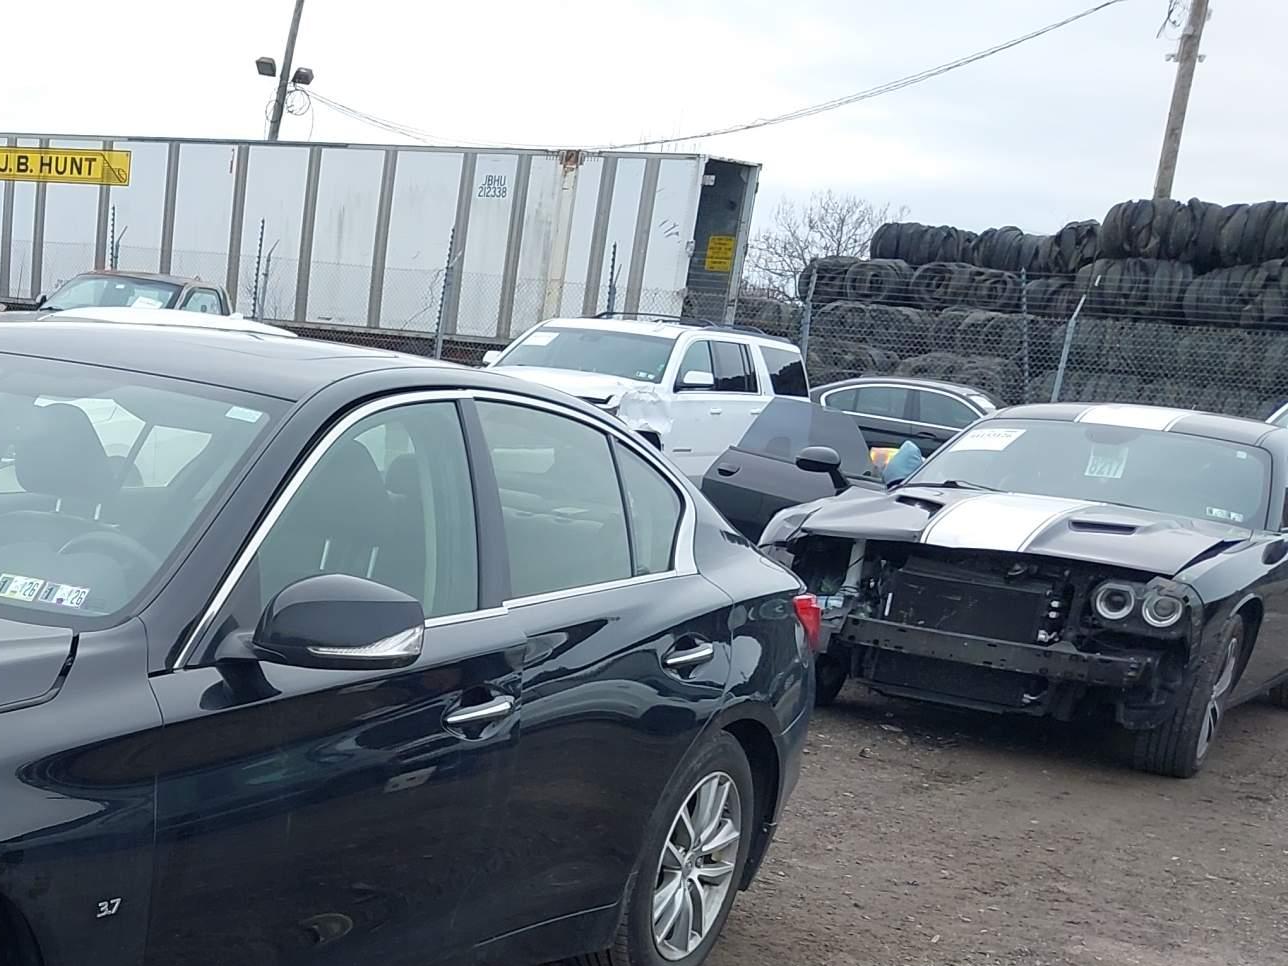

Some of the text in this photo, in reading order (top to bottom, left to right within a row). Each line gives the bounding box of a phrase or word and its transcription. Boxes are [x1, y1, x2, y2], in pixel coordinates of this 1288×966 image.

[39, 156, 97, 177] HUNT
[482, 174, 507, 187] JBHU
[478, 186, 508, 198] 212338
